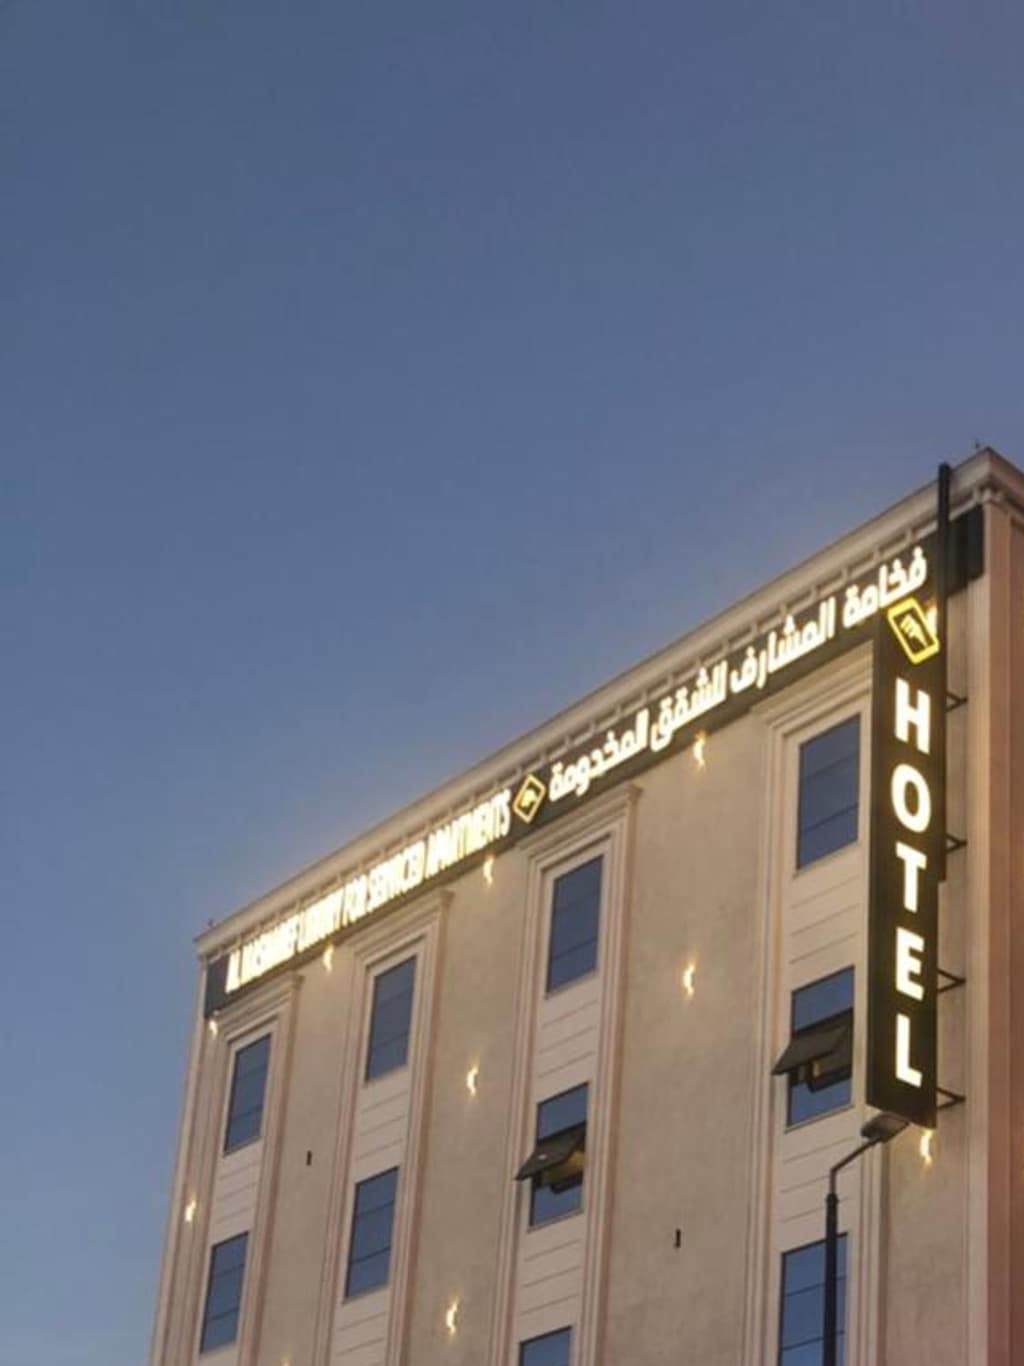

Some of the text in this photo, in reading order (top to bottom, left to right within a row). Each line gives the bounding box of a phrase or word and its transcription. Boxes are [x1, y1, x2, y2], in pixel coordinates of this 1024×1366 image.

[549, 546, 927, 802] فخامة المشارف للشقق المخدومة
[891, 677, 932, 1088] HOTEL
